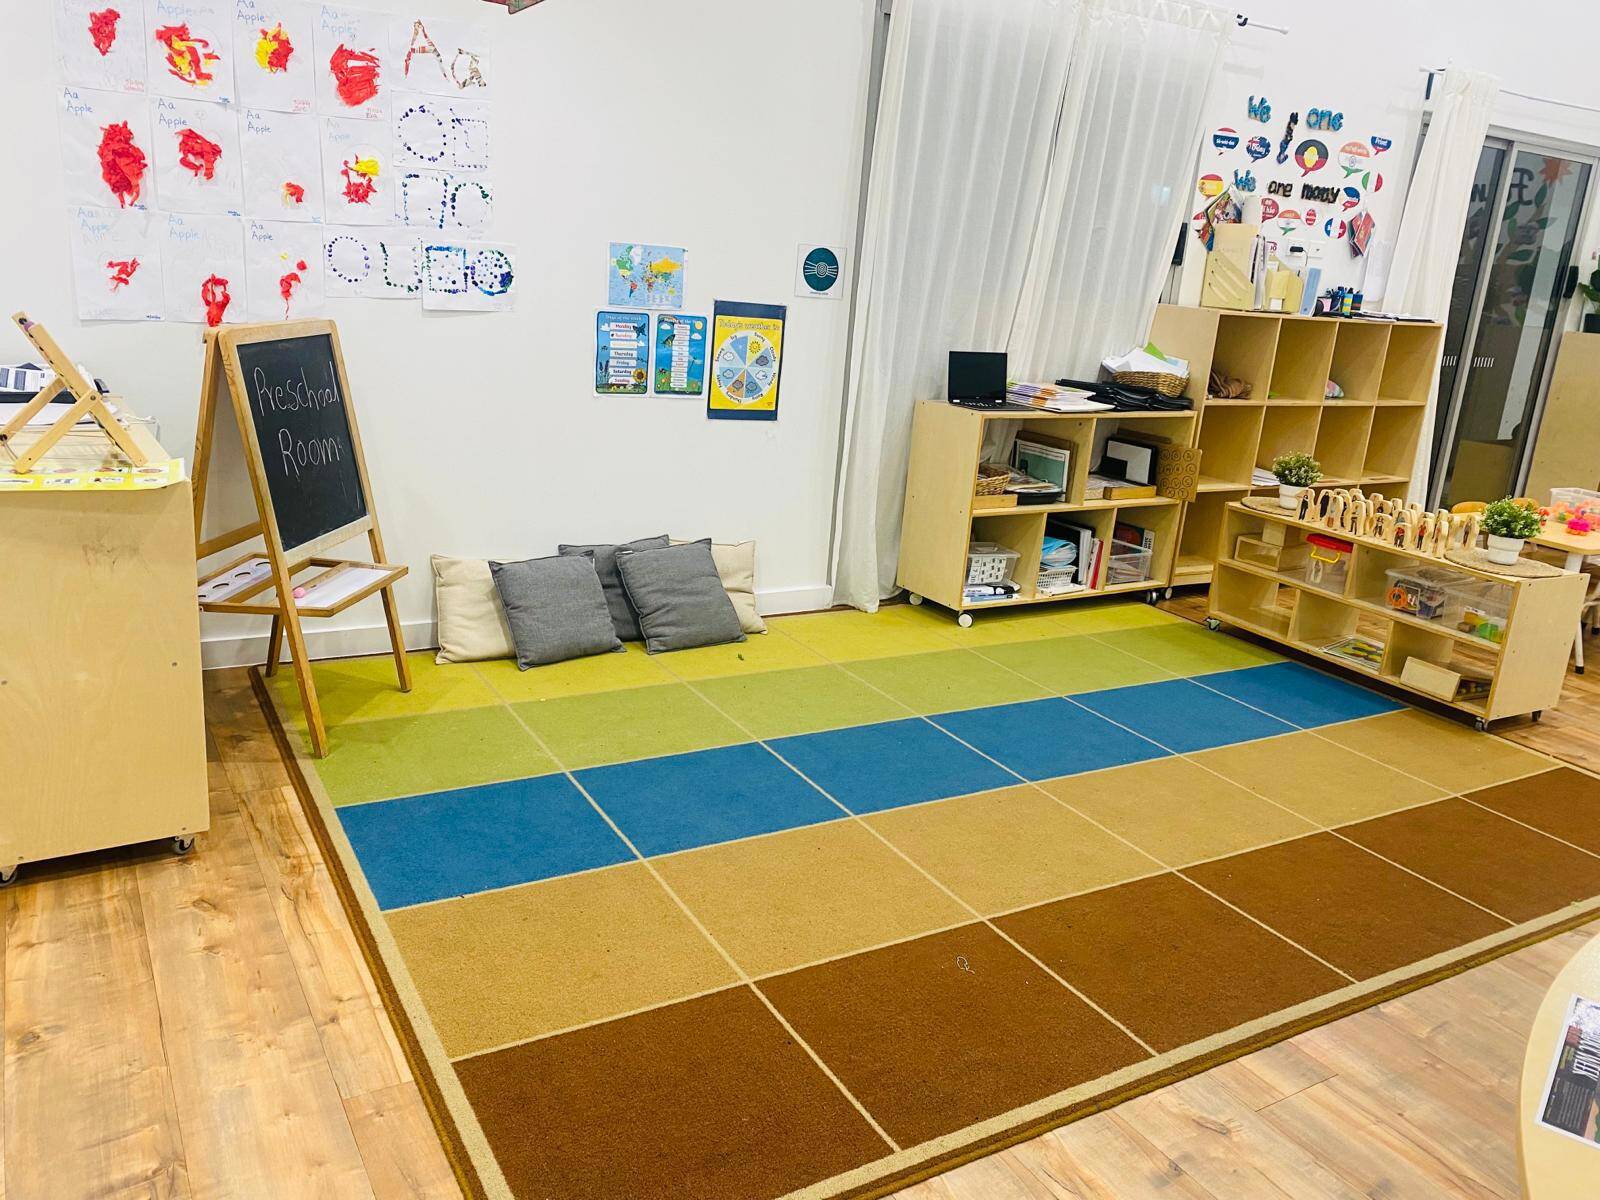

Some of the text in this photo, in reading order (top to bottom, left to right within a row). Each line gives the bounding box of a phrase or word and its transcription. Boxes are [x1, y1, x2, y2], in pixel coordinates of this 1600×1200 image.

[237, 10, 265, 24] Apple
[321, 5, 338, 19] Aa
[321, 20, 352, 38] Apple
[63, 88, 79, 99] Aa
[67, 101, 93, 115] Apple
[158, 98, 176, 110] Aa
[246, 110, 260, 120] Aa
[1247, 95, 1344, 132] We one
[159, 114, 188, 128] Apple
[247, 121, 272, 134] Apple
[1234, 168, 1341, 204] We are many
[77, 207, 96, 218] Aa
[168, 213, 184, 225] Aa
[251, 221, 264, 230] Aa
[170, 227, 200, 241] Apple
[252, 231, 273, 242] Apple
[278, 428, 339, 477] Room
